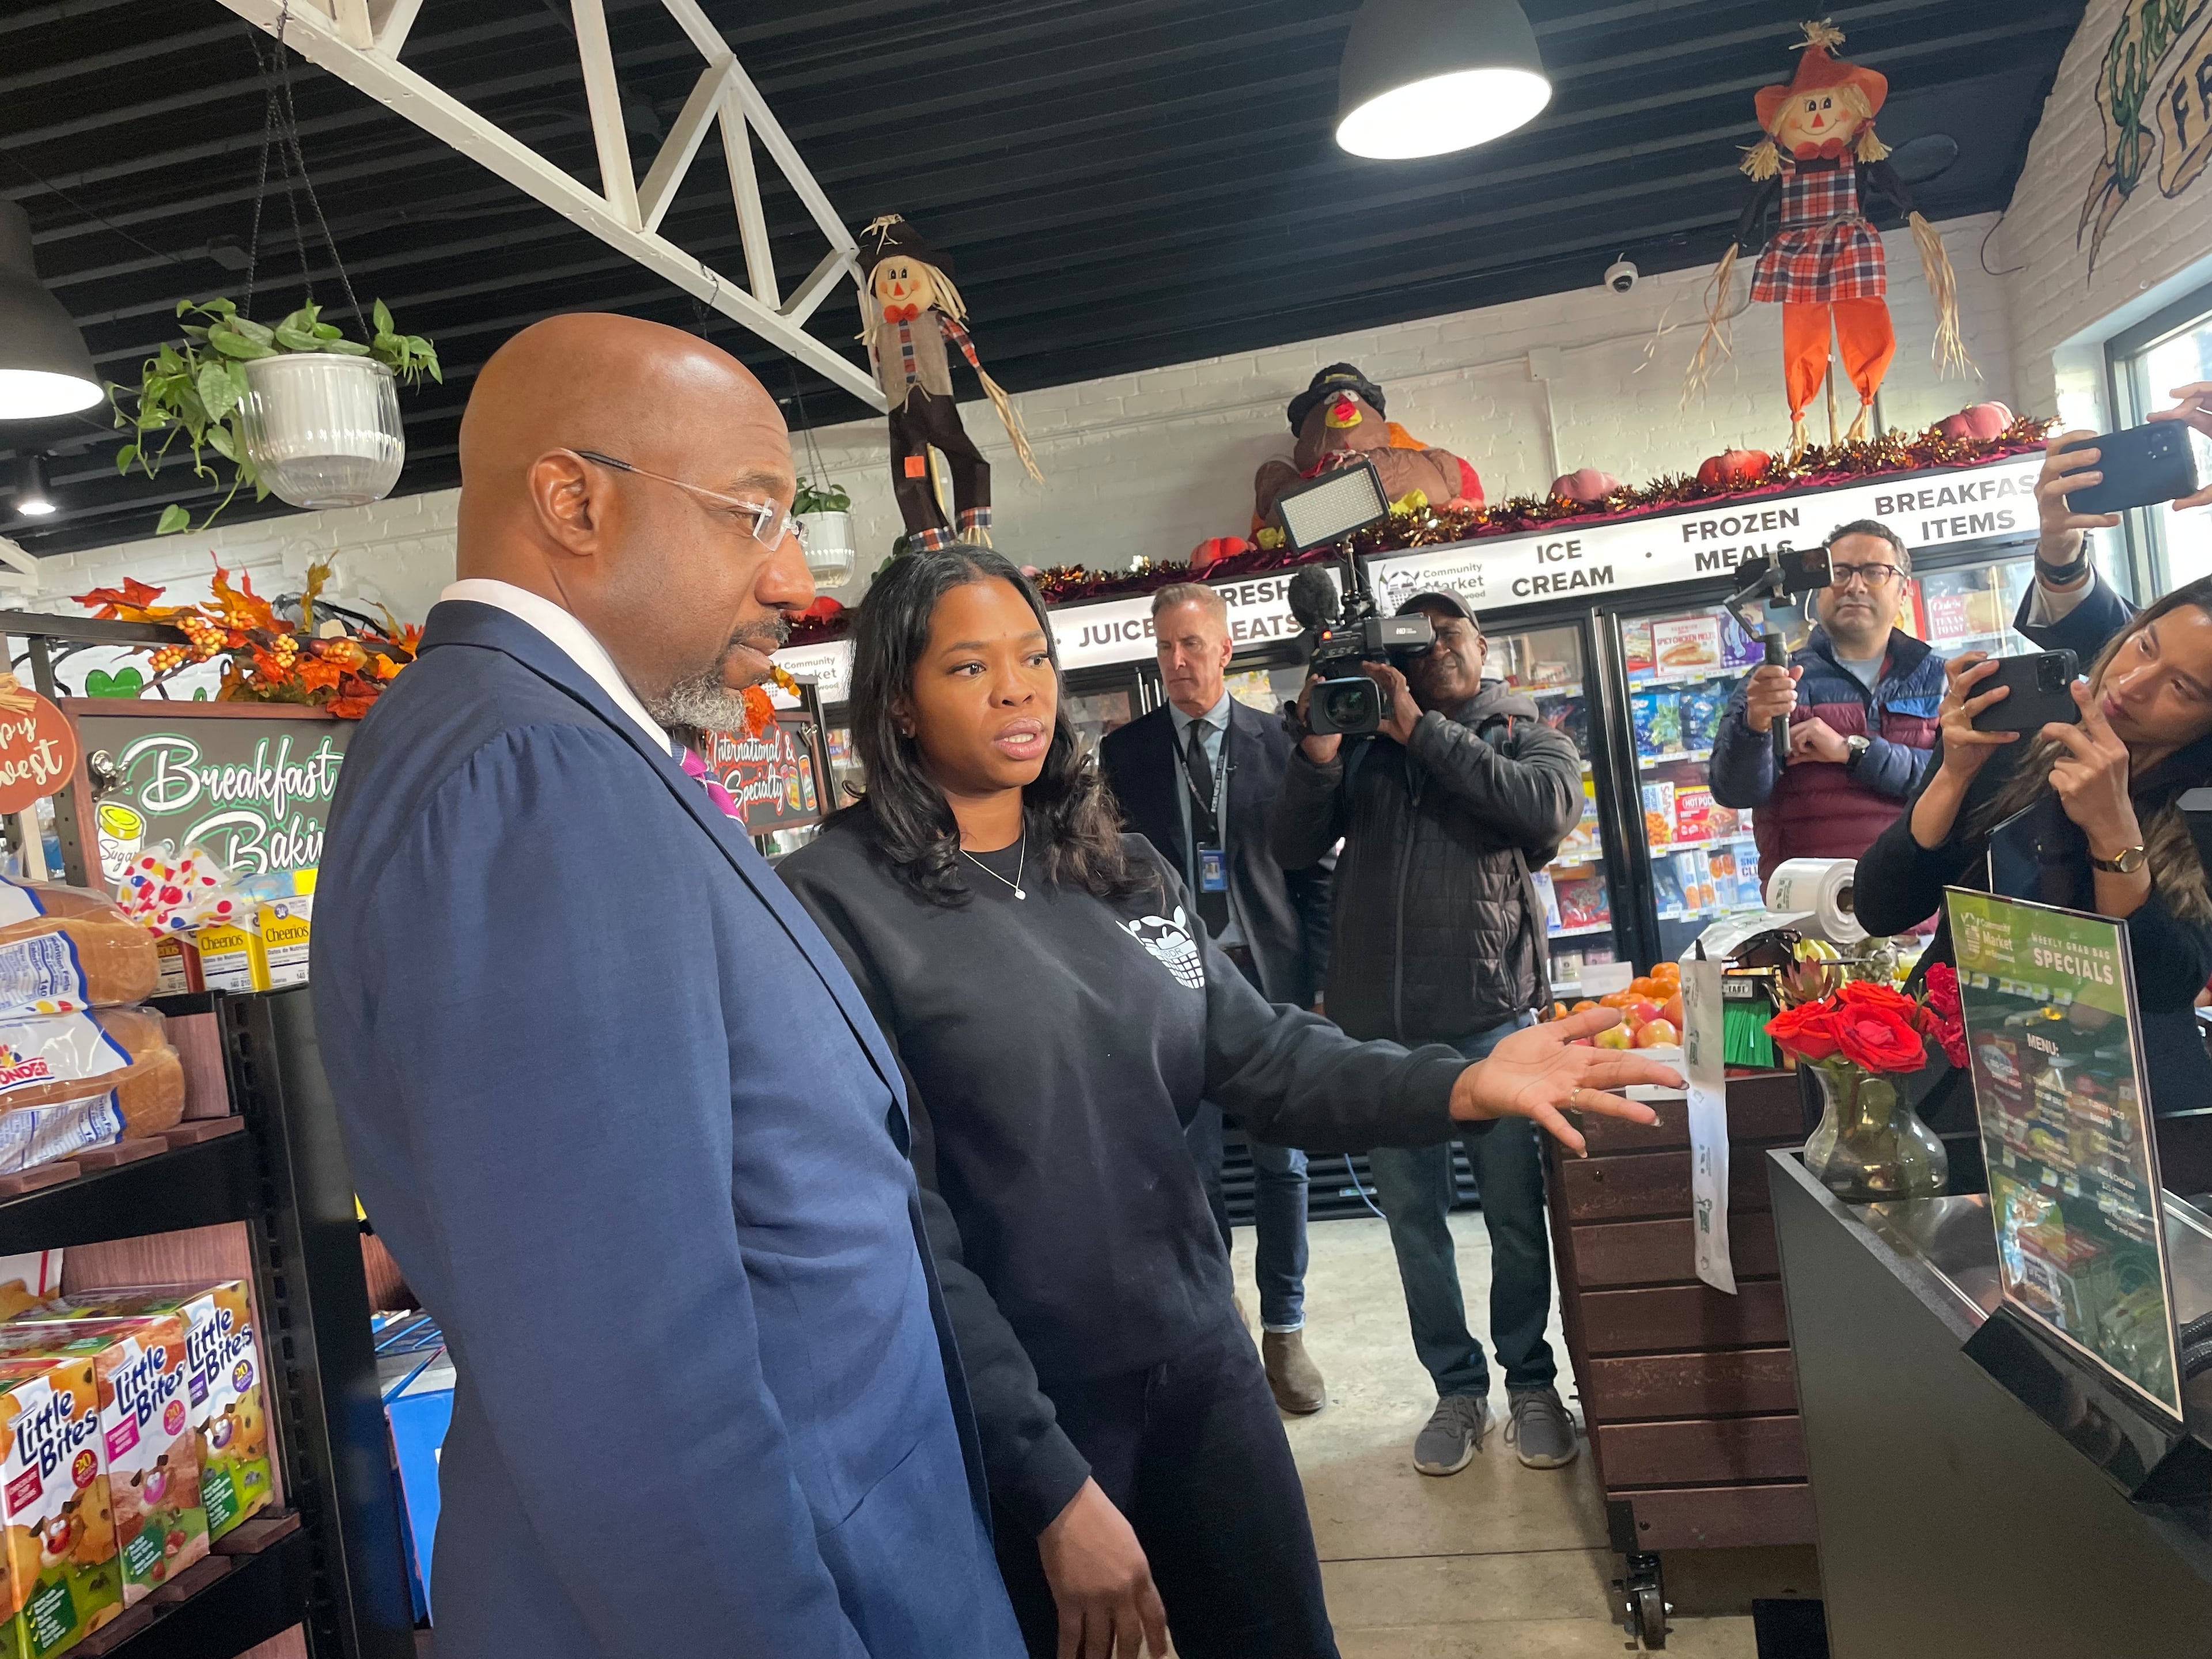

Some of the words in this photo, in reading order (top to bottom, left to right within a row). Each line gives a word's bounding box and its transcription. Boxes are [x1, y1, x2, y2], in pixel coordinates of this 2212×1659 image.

[1875, 474, 2039, 516] BREAKFAS
[1682, 507, 1800, 543] FROZEN
[1922, 510, 2015, 540] ITEMS
[1537, 540, 1582, 563] ICE
[1423, 563, 1482, 578] Community
[1512, 565, 1613, 596] CREAM
[1215, 579, 1291, 607] RESH
[1231, 614, 1303, 641] EATS
[785, 656, 835, 669] Community
[709, 730, 781, 767] International
[785, 734, 796, 763] &
[123, 737, 344, 820] Breakfast
[724, 763, 782, 817] Specialty
[1685, 797, 1698, 807] HOT
[99, 839, 136, 872] Suga
[202, 934, 243, 950] Cheerios
[266, 925, 309, 942] Cheerios
[1983, 931, 2013, 950] Market
[2031, 932, 2062, 948] WEEKLY
[2066, 942, 2089, 955] GRAB
[2092, 948, 2111, 960] BAG
[2033, 947, 2114, 985] SPECIALS
[2027, 1033, 2060, 1058] MENU:
[187, 1309, 232, 1373] Little
[206, 1325, 252, 1385] Bites
[116, 1347, 165, 1416] Little
[234, 1363, 248, 1381] 20
[136, 1363, 184, 1427] Bites
[17, 1392, 74, 1467] Little
[40, 1410, 97, 1480] Bites
[75, 1453, 92, 1475] 20
